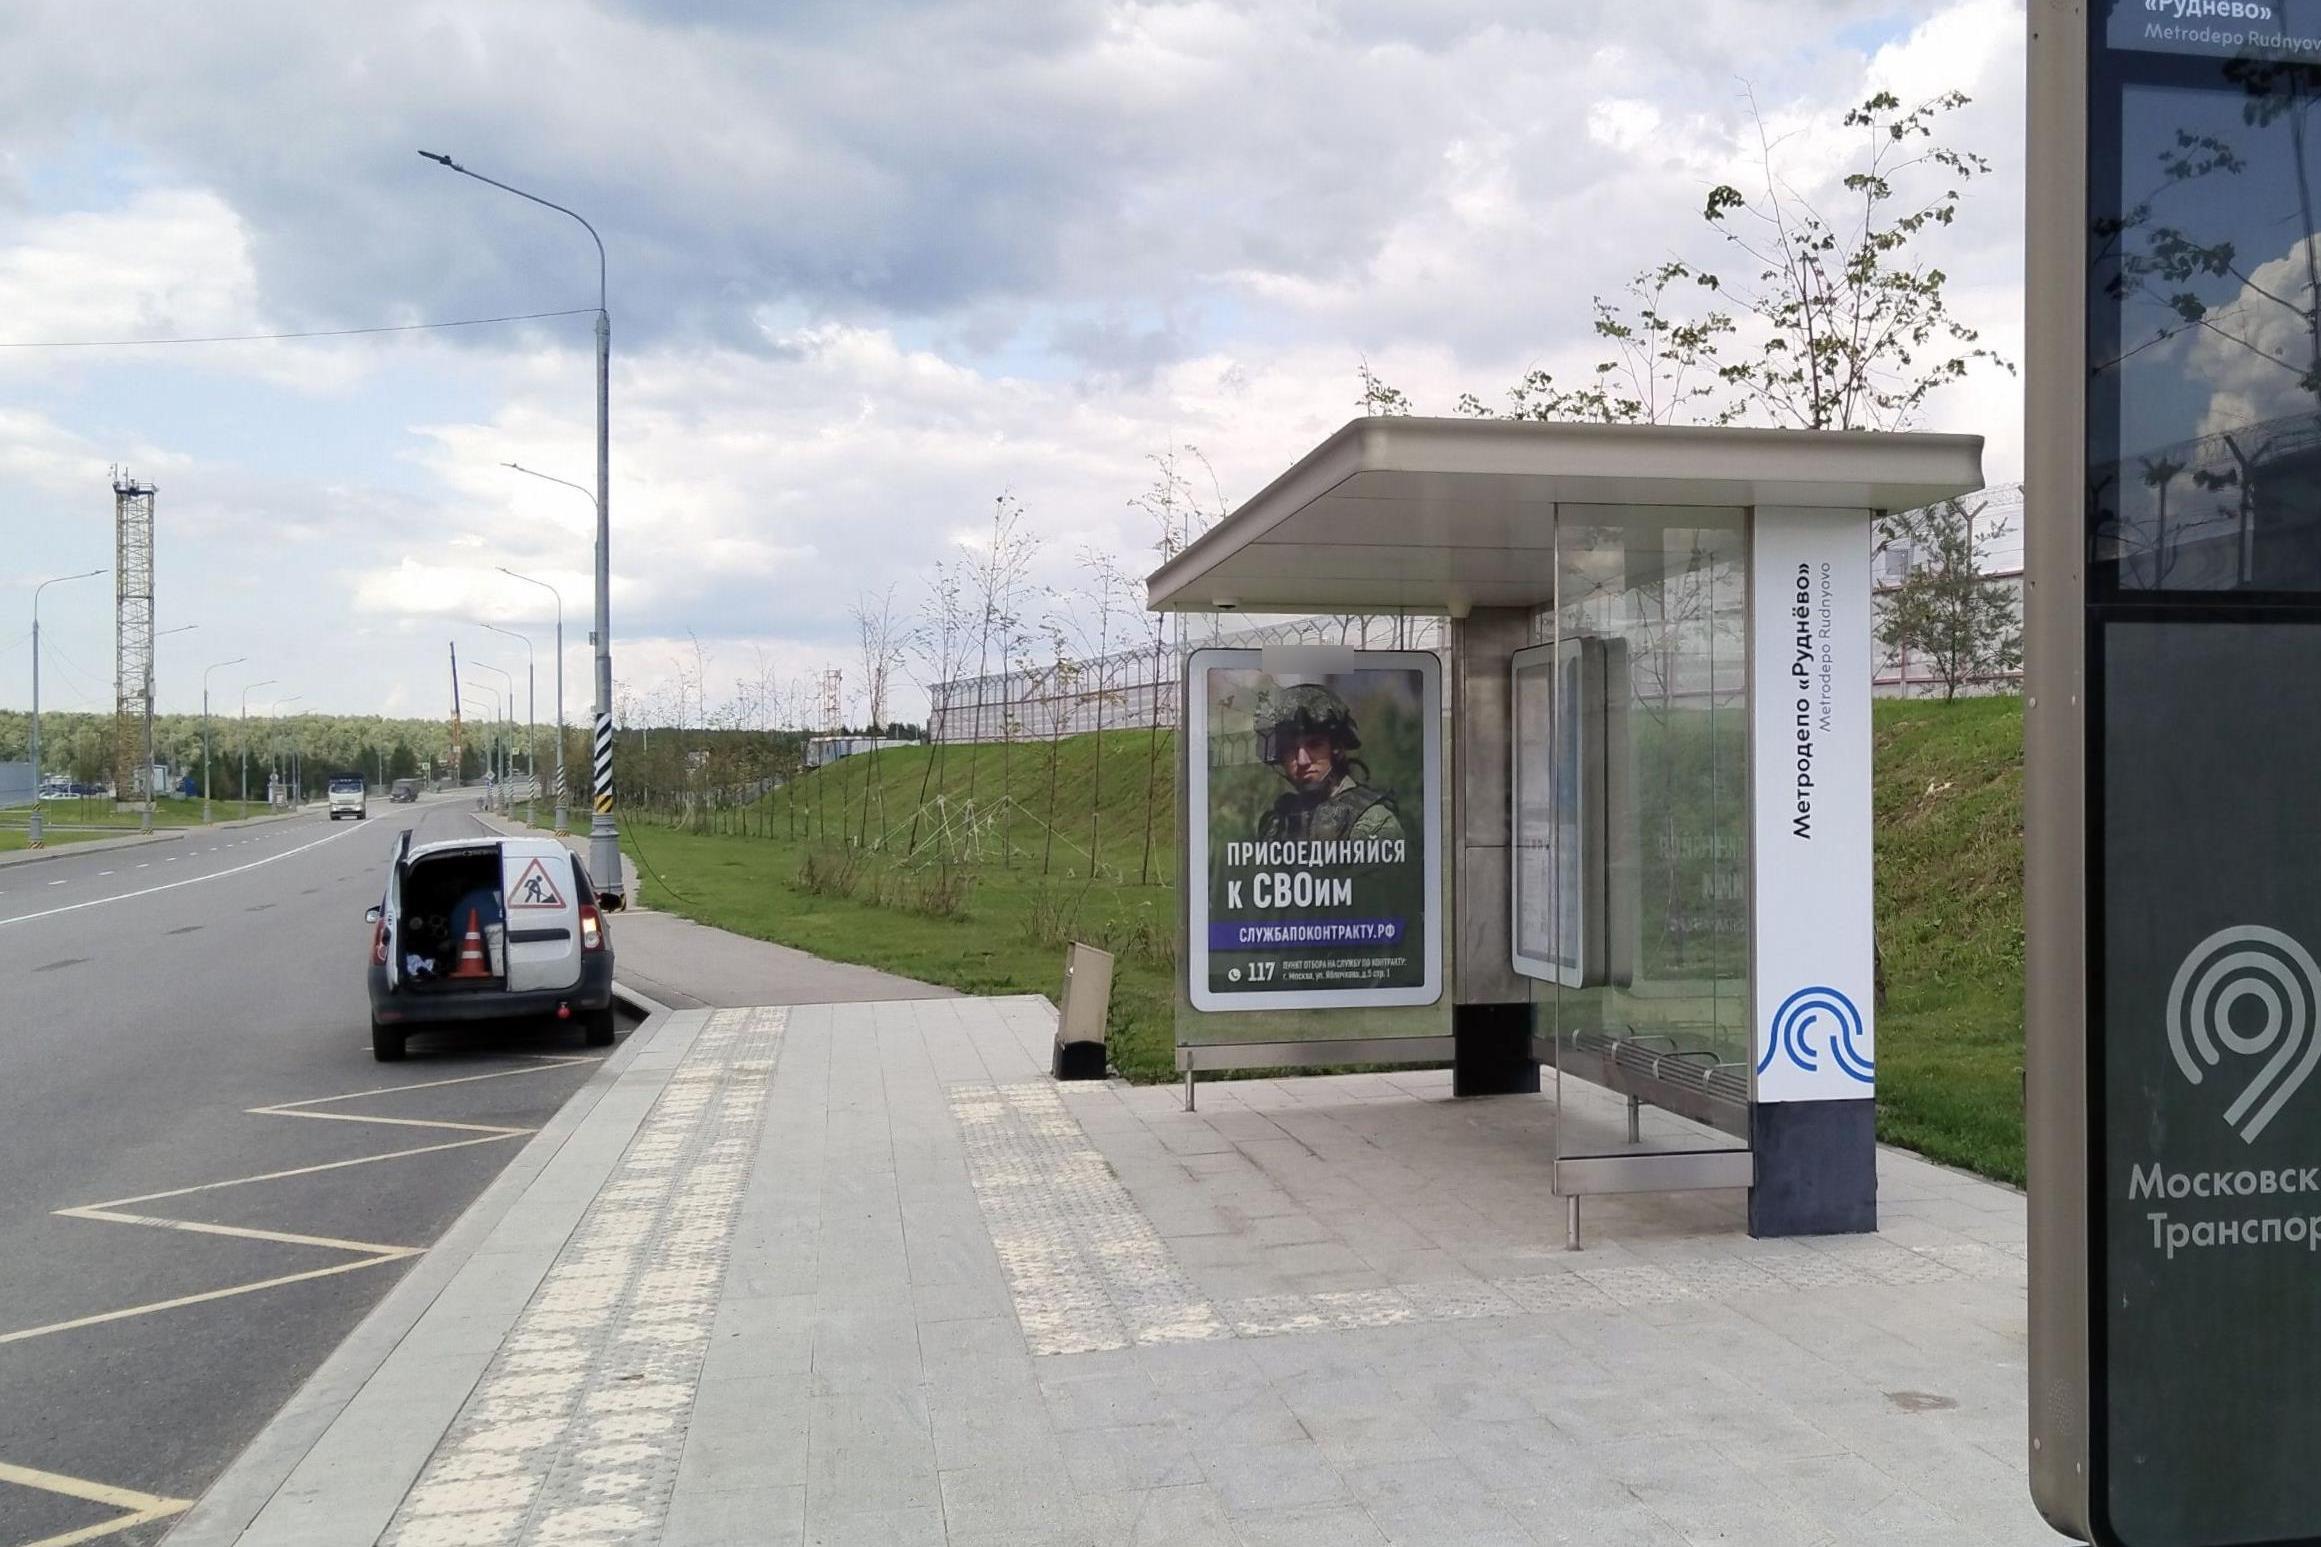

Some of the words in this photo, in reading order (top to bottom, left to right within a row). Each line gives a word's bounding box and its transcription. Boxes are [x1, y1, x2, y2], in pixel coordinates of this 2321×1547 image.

[2144, 23, 2244, 47] Metrodepo
[1791, 562, 1814, 690] «Руднёво»
[1819, 562, 1832, 638] Rudnyovo
[1819, 644, 1832, 732] Metrodepo
[1793, 698, 1814, 840] Метродепо
[1227, 835, 1406, 867] ПРИСОЕДИНЯЙСЯ
[1239, 923, 1395, 943] СЛУЖБАПОКОНТРАКТУ.РФ
[1248, 962, 1275, 981] 117
